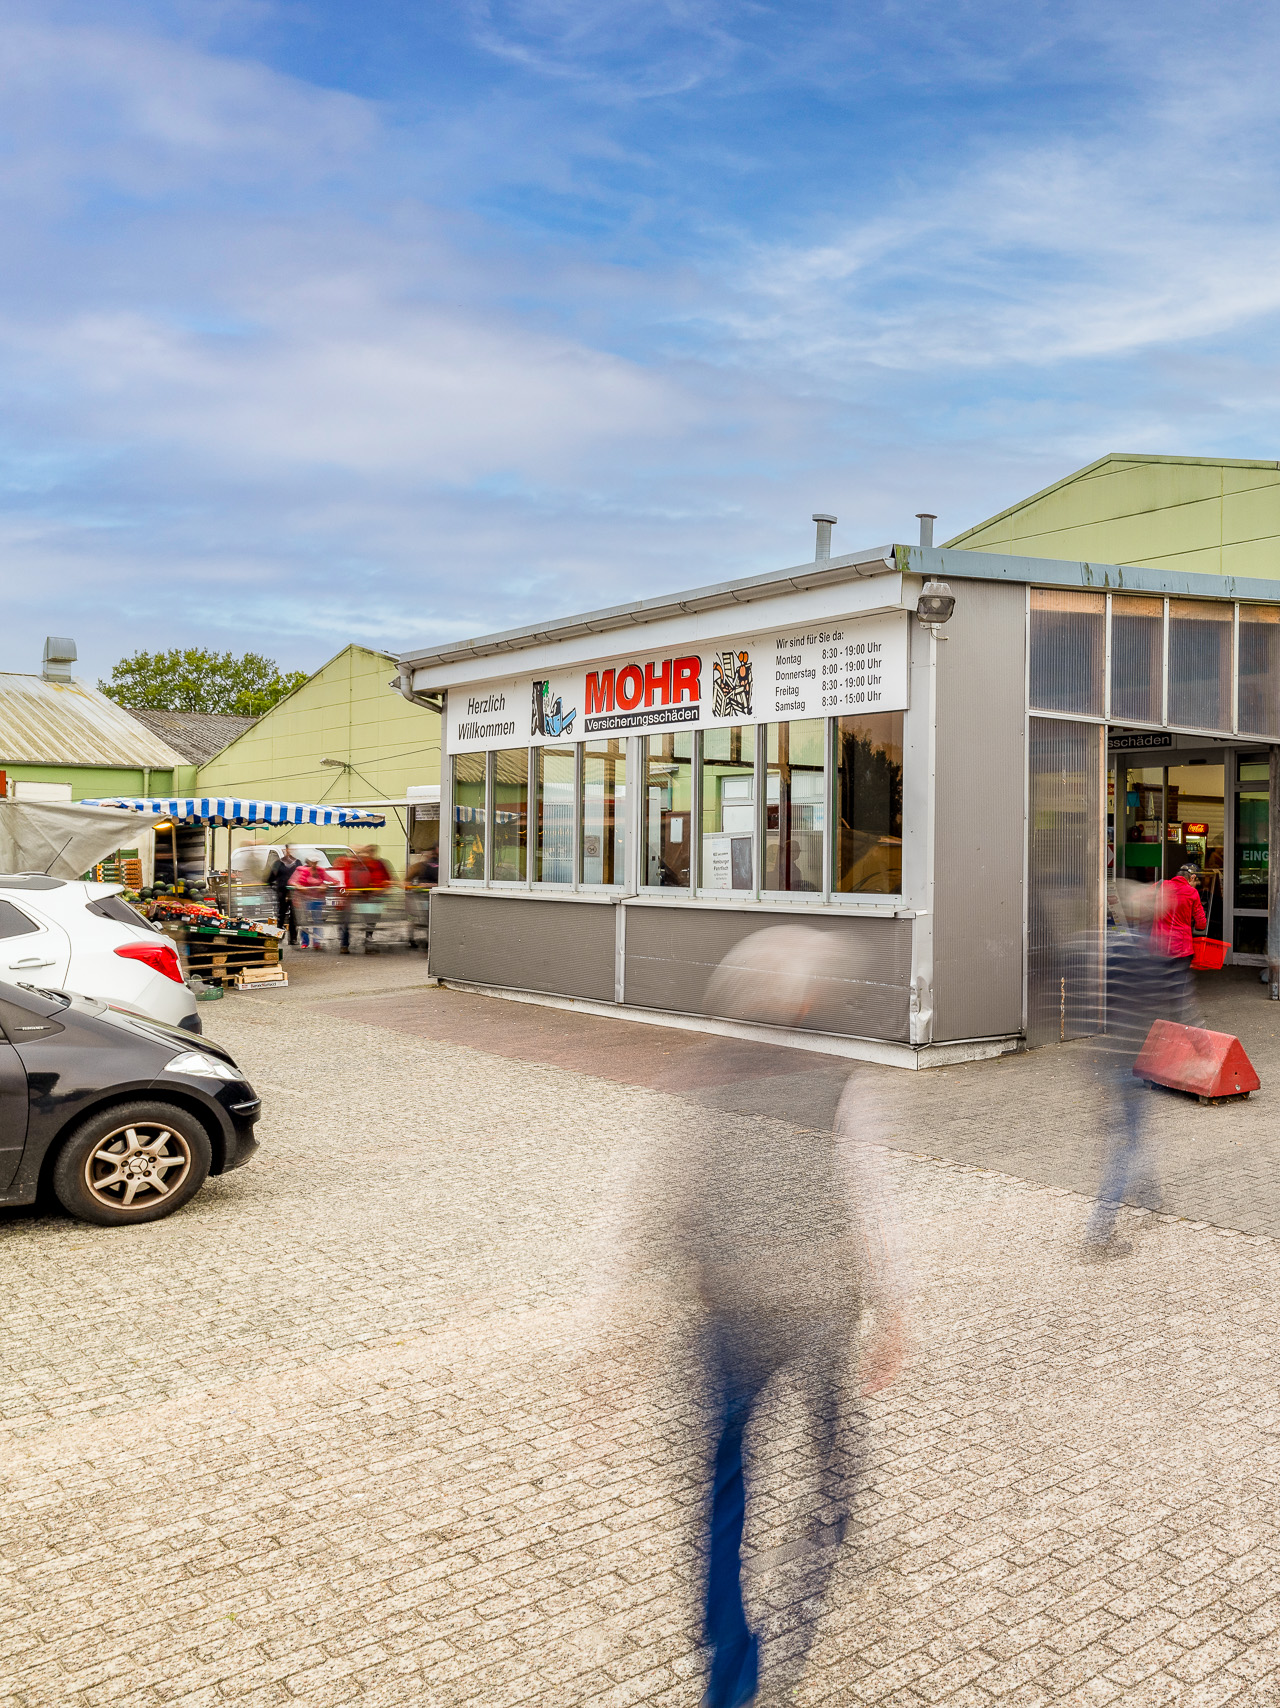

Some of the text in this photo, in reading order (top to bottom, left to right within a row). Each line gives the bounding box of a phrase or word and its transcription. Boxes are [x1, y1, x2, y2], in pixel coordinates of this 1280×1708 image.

[776, 630, 844, 649] Wir sind für Sie da:
[776, 654, 802, 666] Montag
[822, 648, 838, 660] 8:30
[845, 643, 865, 656] 19:00
[867, 642, 882, 654] Uhr
[776, 668, 816, 681] Donnerstag
[822, 663, 838, 676] 8:00
[845, 659, 865, 672] 19:00
[867, 658, 882, 670] Uhr
[585, 655, 702, 715] MOHR
[775, 685, 800, 697] Freitag
[822, 679, 838, 691] 8:30
[845, 675, 865, 688] 19:00
[867, 674, 882, 686] Uhr
[467, 693, 505, 715] Herzlich
[775, 700, 806, 712] Samstag
[822, 695, 838, 707] 8:30
[845, 691, 865, 704] 15:00
[867, 690, 882, 702] Uhr
[458, 721, 515, 740] Willkommen
[587, 709, 698, 730] Versicherungsschäden
[1108, 736, 1170, 748] sschäden
